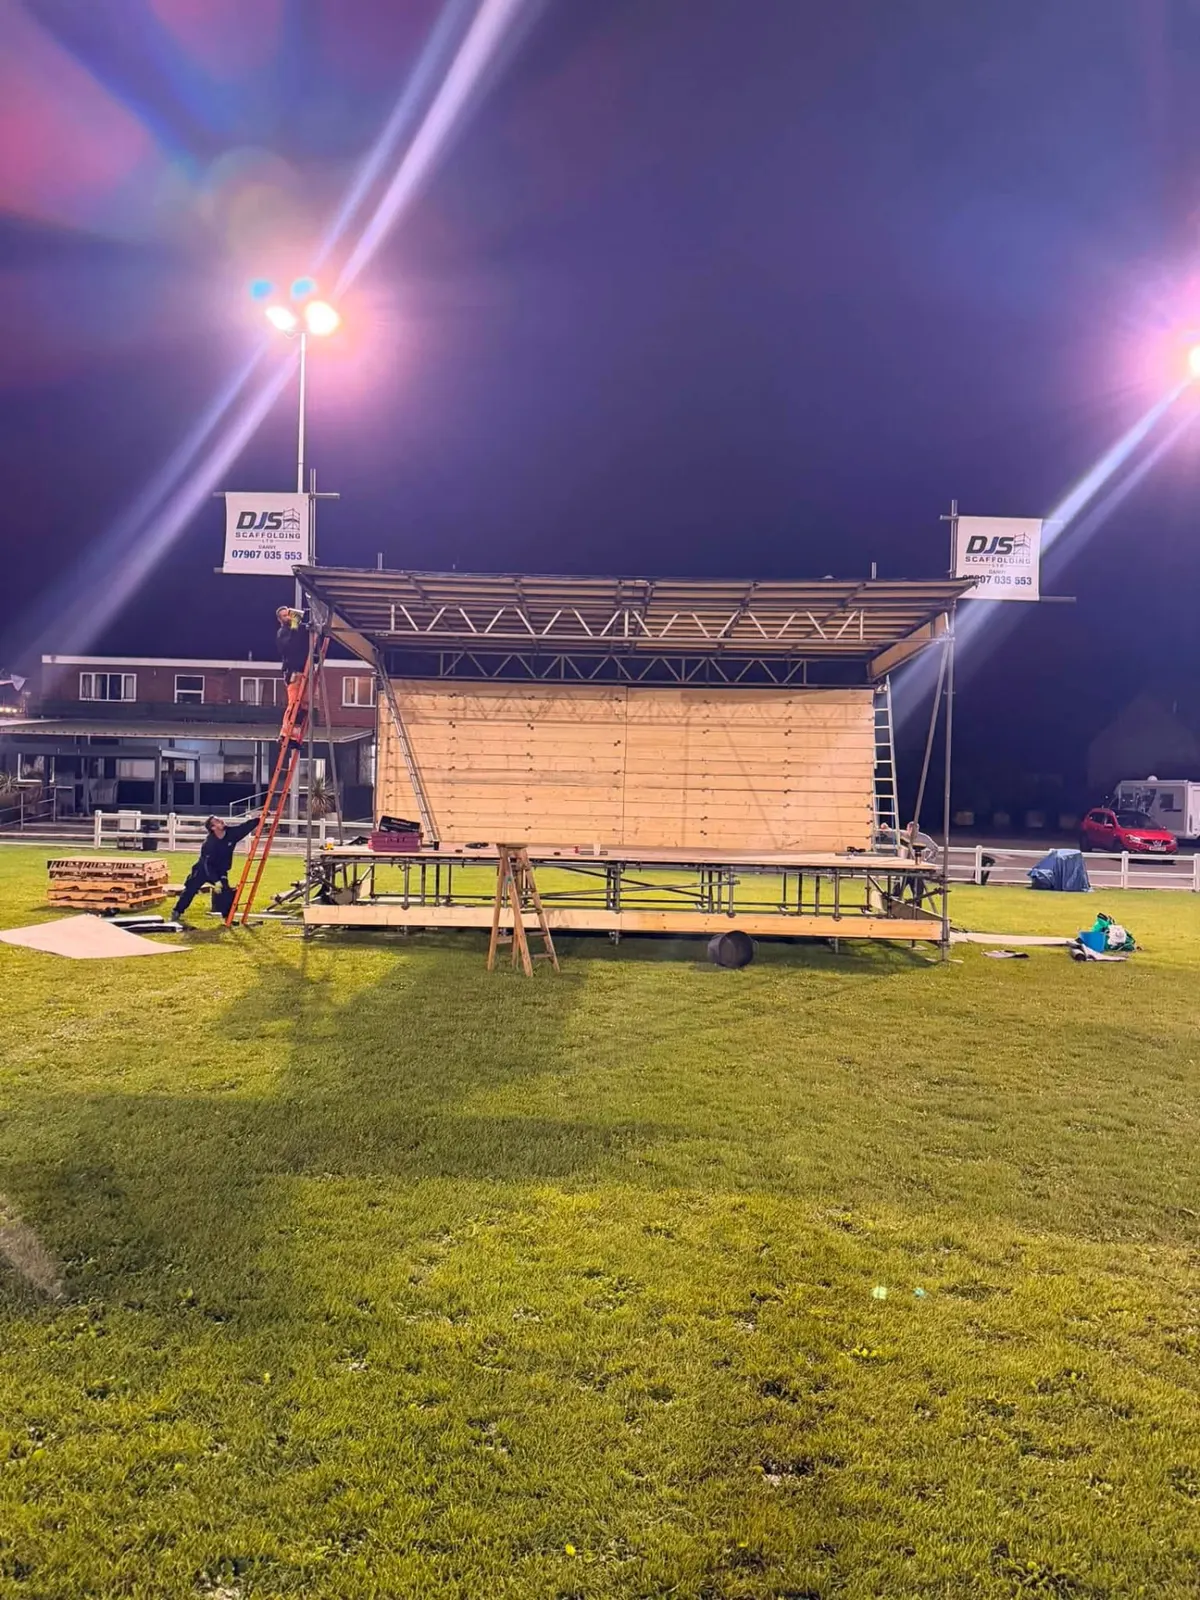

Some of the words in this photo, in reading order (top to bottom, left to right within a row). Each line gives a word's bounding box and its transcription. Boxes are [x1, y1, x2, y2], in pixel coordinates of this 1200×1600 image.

[236, 511, 283, 530] DJS
[966, 535, 1015, 555] DJS
[232, 550, 262, 559] 07907
[264, 550, 282, 560] 035
[284, 551, 302, 560] 553
[965, 556, 1031, 564] SCAFFOLDING
[994, 575, 1012, 585] 035
[1014, 576, 1032, 585] 553
